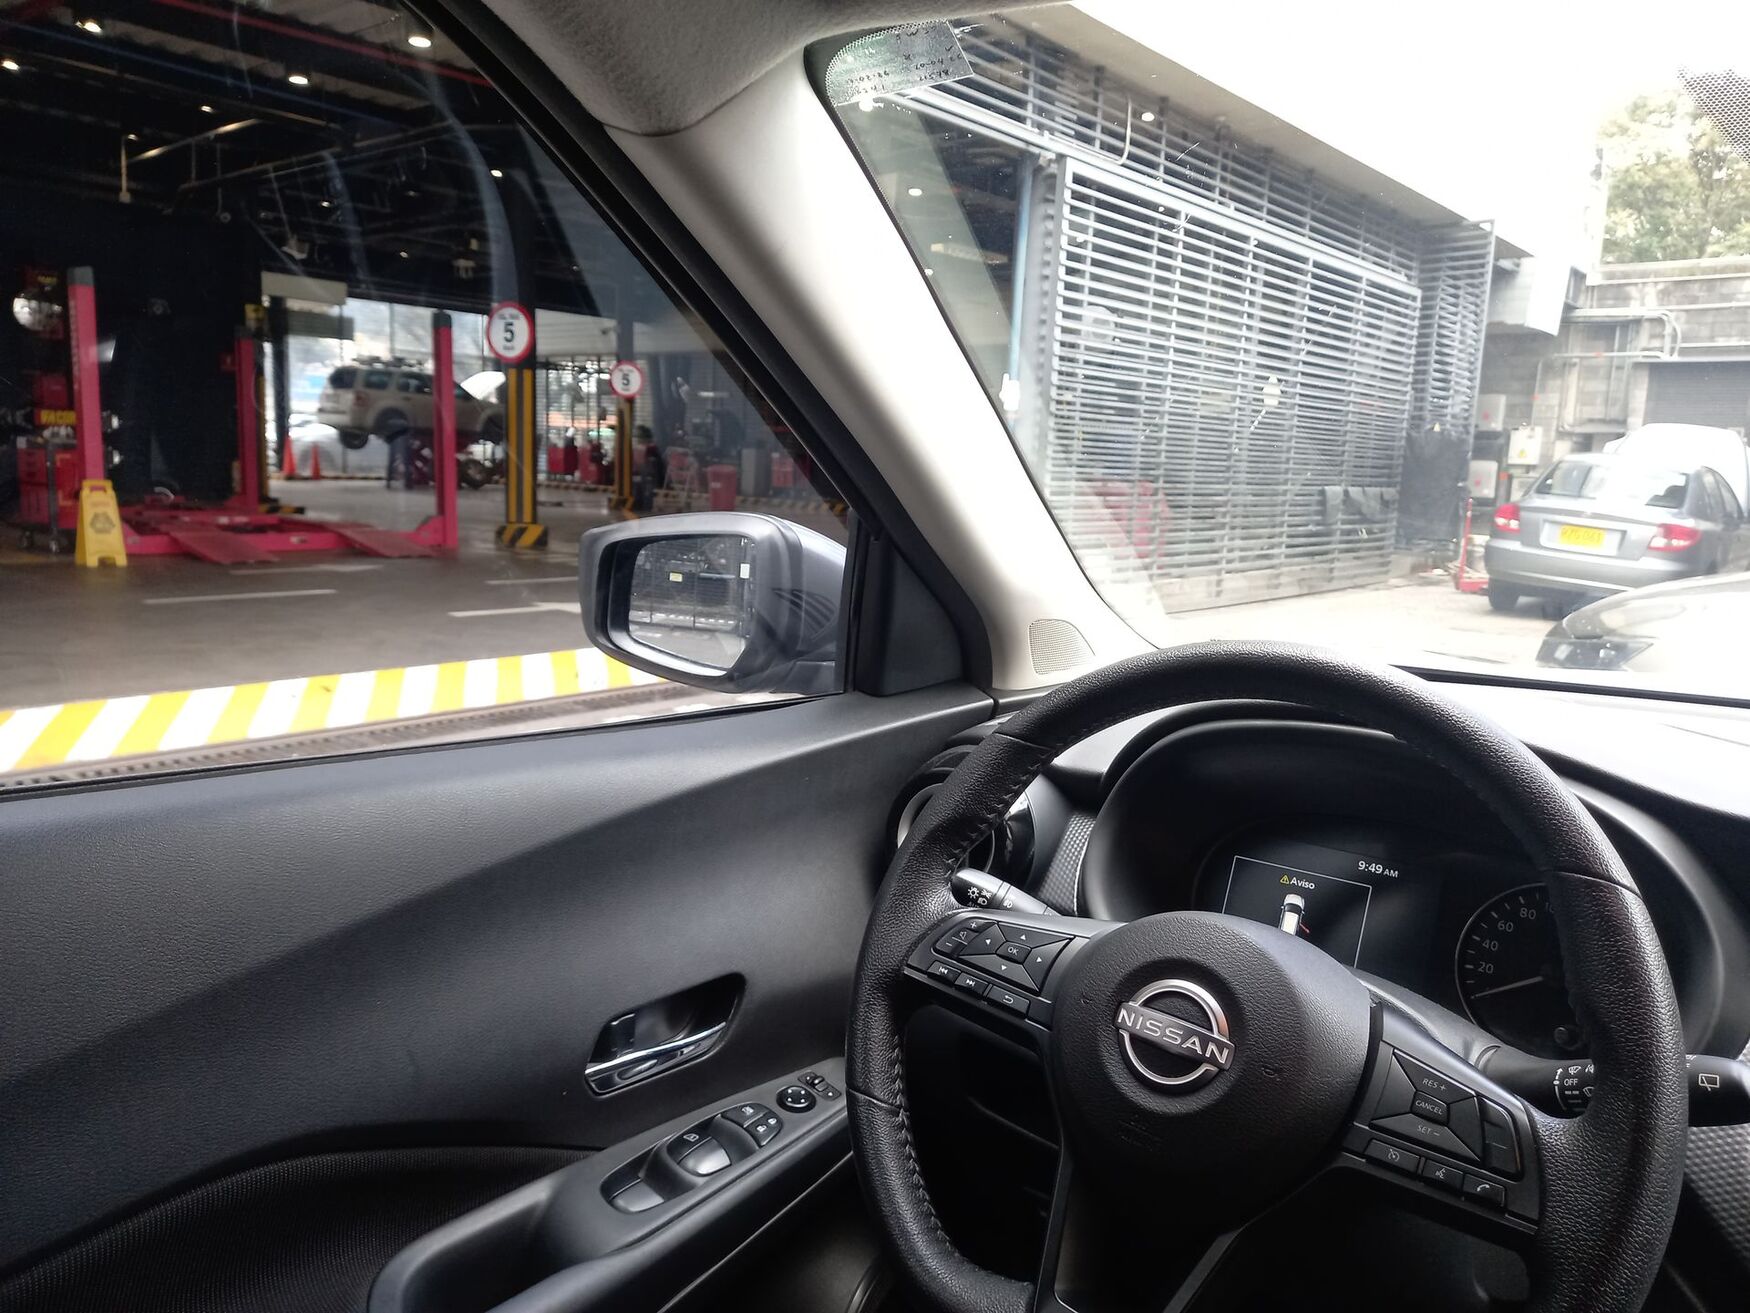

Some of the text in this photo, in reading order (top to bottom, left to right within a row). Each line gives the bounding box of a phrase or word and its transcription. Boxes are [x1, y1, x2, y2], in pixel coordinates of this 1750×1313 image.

[503, 321, 515, 343] 5
[621, 372, 631, 386] 5
[1358, 860, 1399, 878] 9:49 AM
[1290, 876, 1316, 890] Aviso
[1519, 907, 1536, 920] 80
[1497, 920, 1514, 933] 60
[1007, 946, 1019, 955] OK
[1482, 939, 1499, 951] 40
[1478, 961, 1494, 974] 20
[1117, 1007, 1229, 1064] NISSAN
[1563, 1078, 1579, 1086] OFF
[1415, 1100, 1443, 1115] CANCEL
